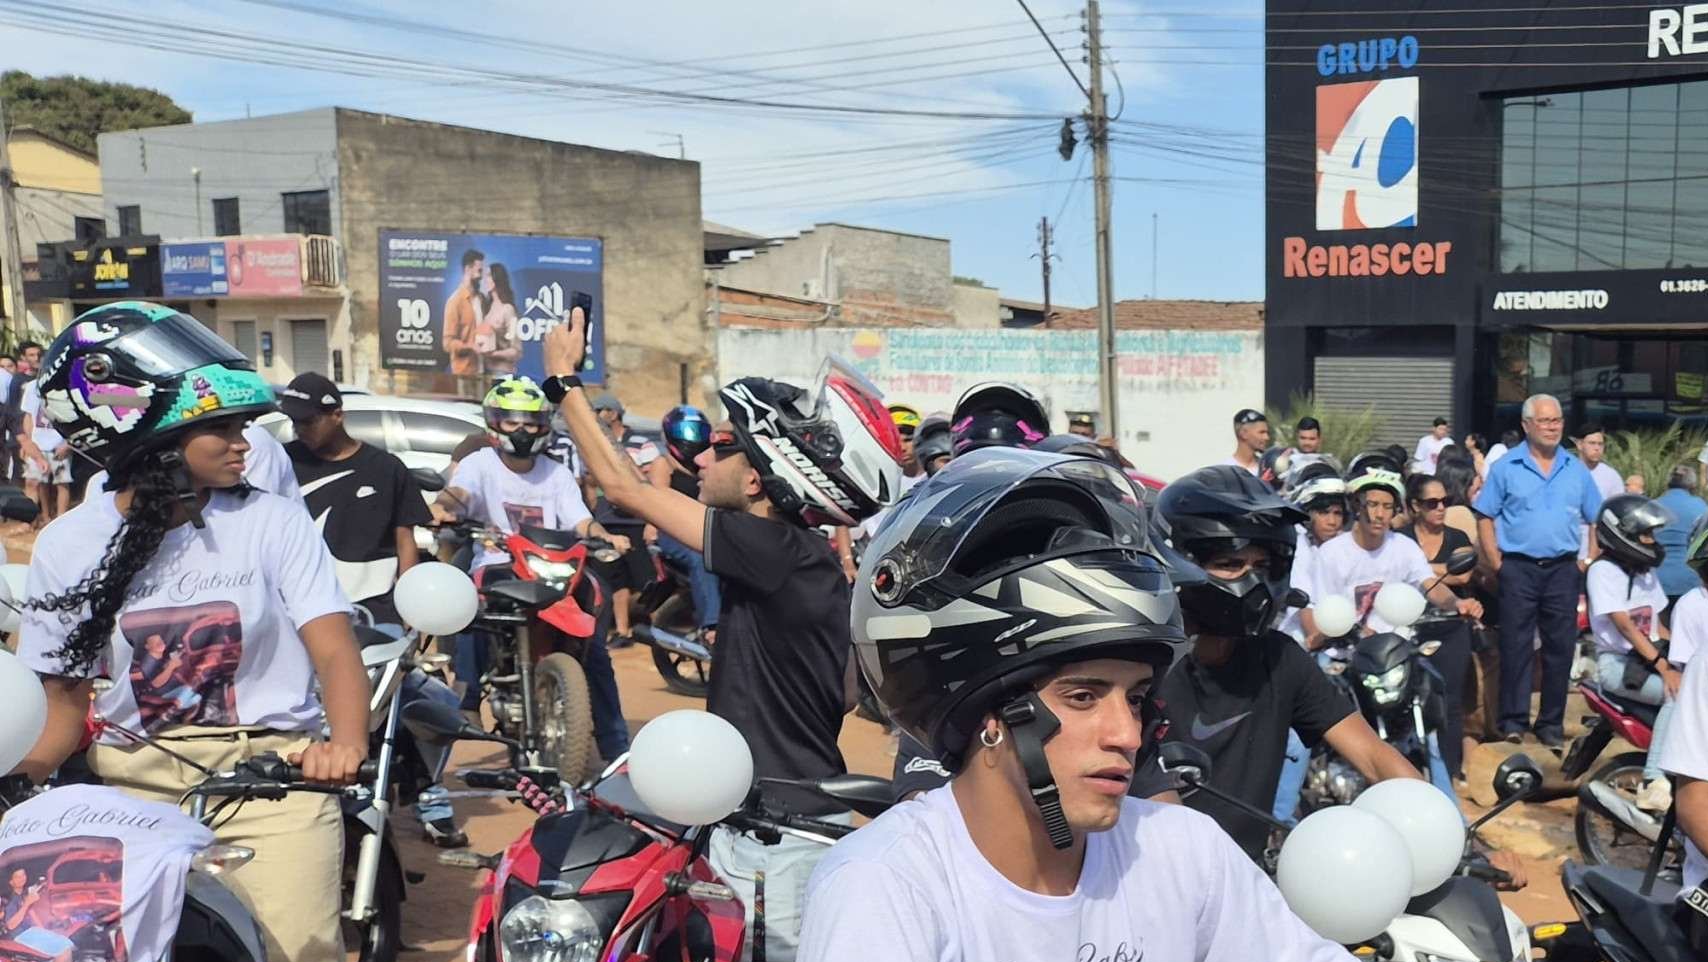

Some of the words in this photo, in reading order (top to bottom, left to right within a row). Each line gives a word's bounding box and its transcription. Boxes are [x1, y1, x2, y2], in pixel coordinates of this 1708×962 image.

[1316, 35, 1419, 76] GRUPO
[1283, 236, 1452, 278] Renascer
[397, 299, 430, 328] 10
[1493, 290, 1608, 310] ATENDIMENTO
